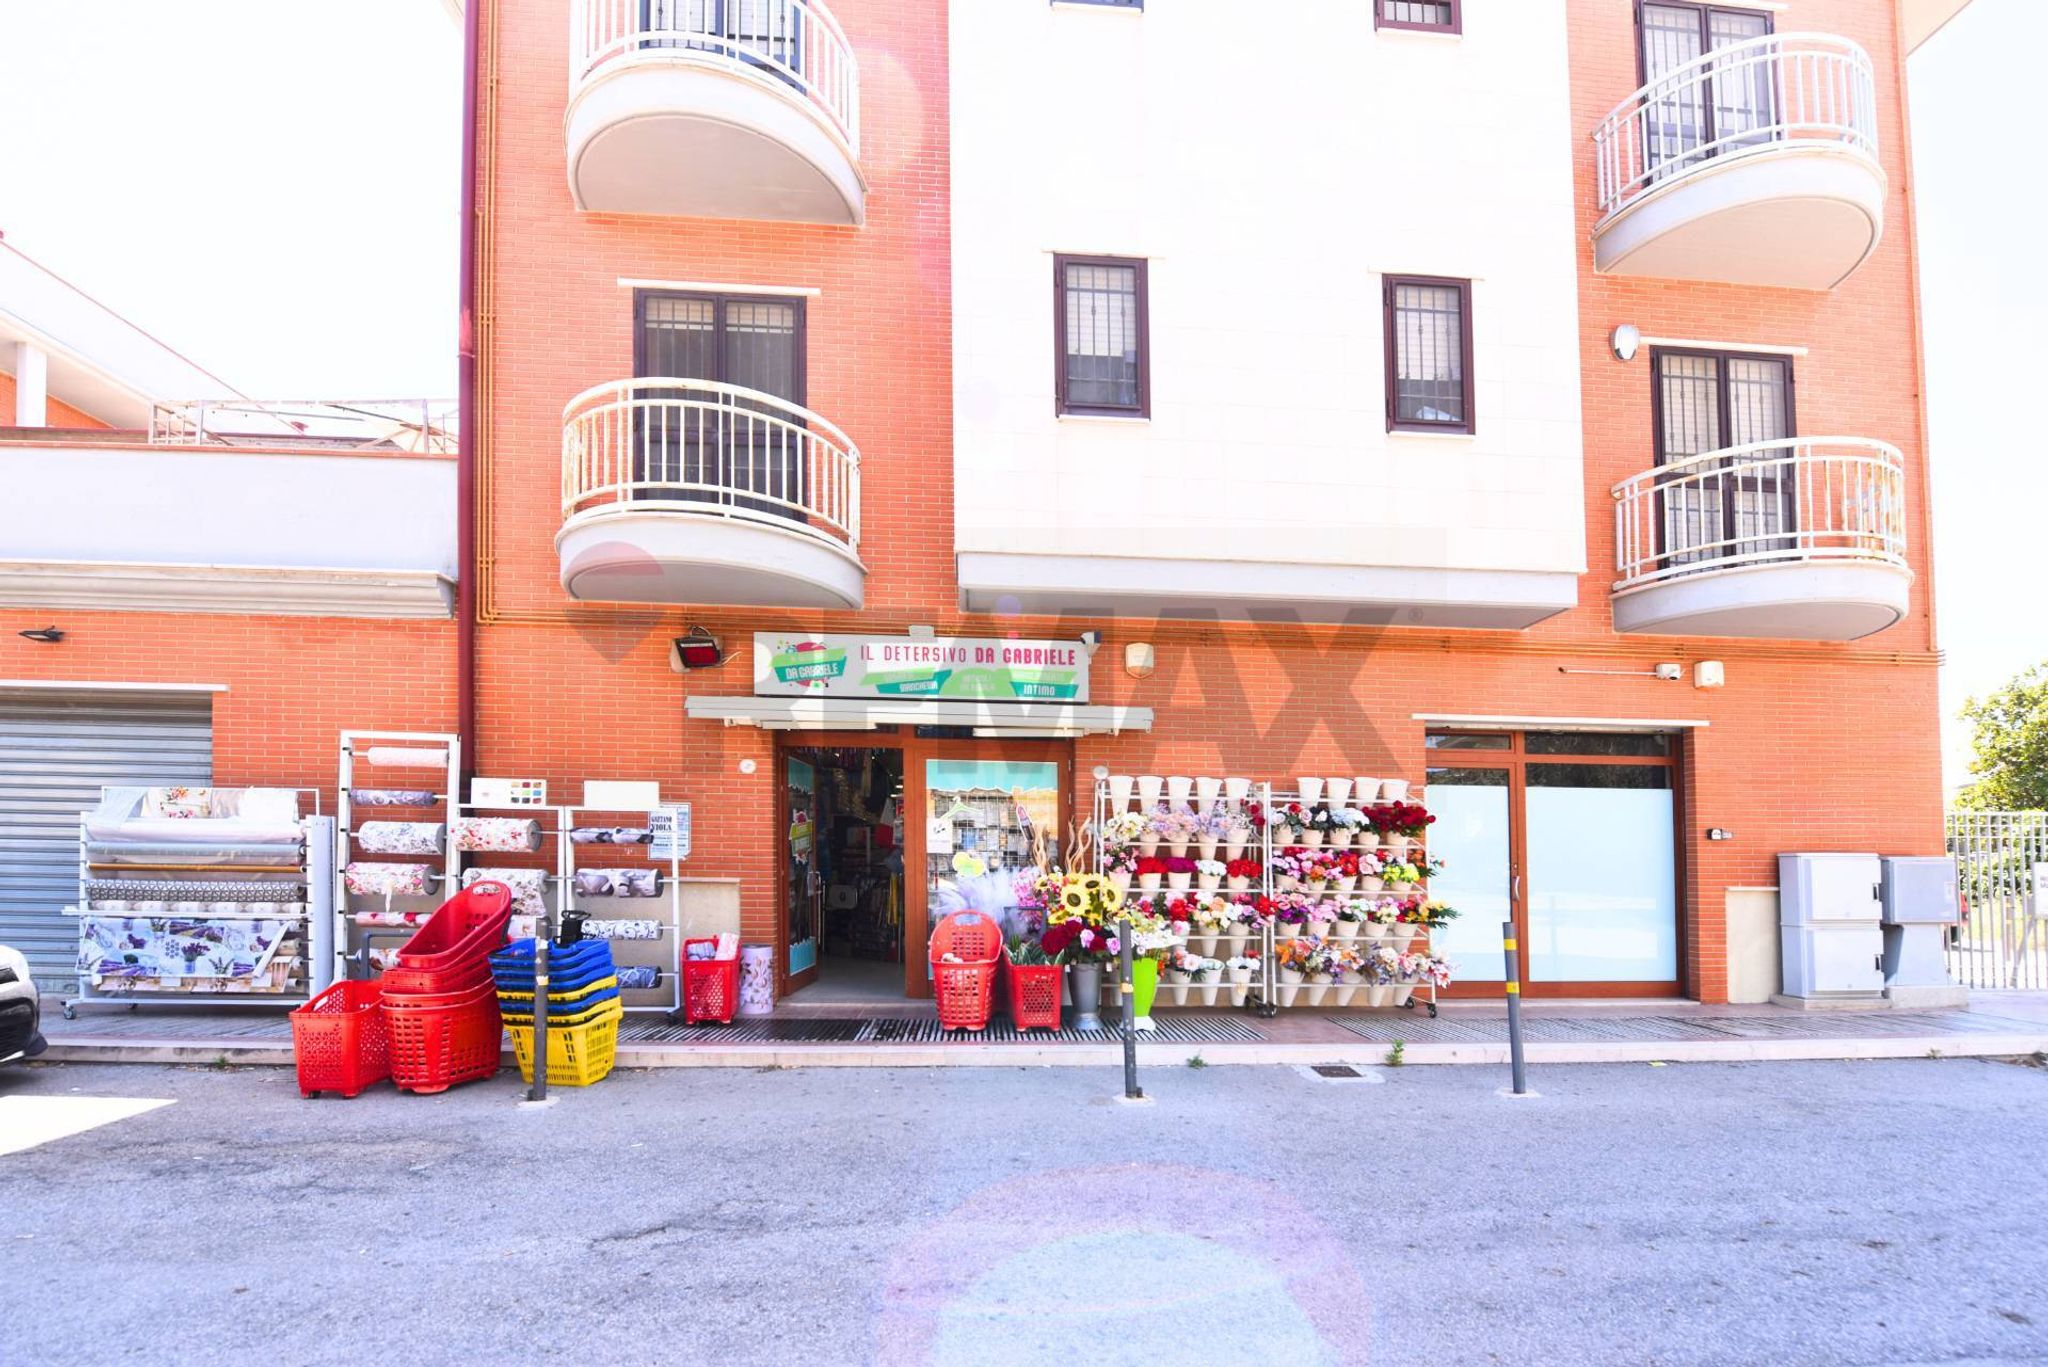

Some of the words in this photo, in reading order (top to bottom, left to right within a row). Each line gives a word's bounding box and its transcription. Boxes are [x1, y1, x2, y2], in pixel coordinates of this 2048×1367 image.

[860, 645, 874, 661] IL
[884, 645, 967, 663] DETERSIVO
[975, 647, 995, 663] DA
[1003, 648, 1076, 665] GABRIELE
[785, 667, 798, 680] DA
[799, 662, 839, 679] GABRIELE
[1023, 684, 1055, 696] INTIMO
